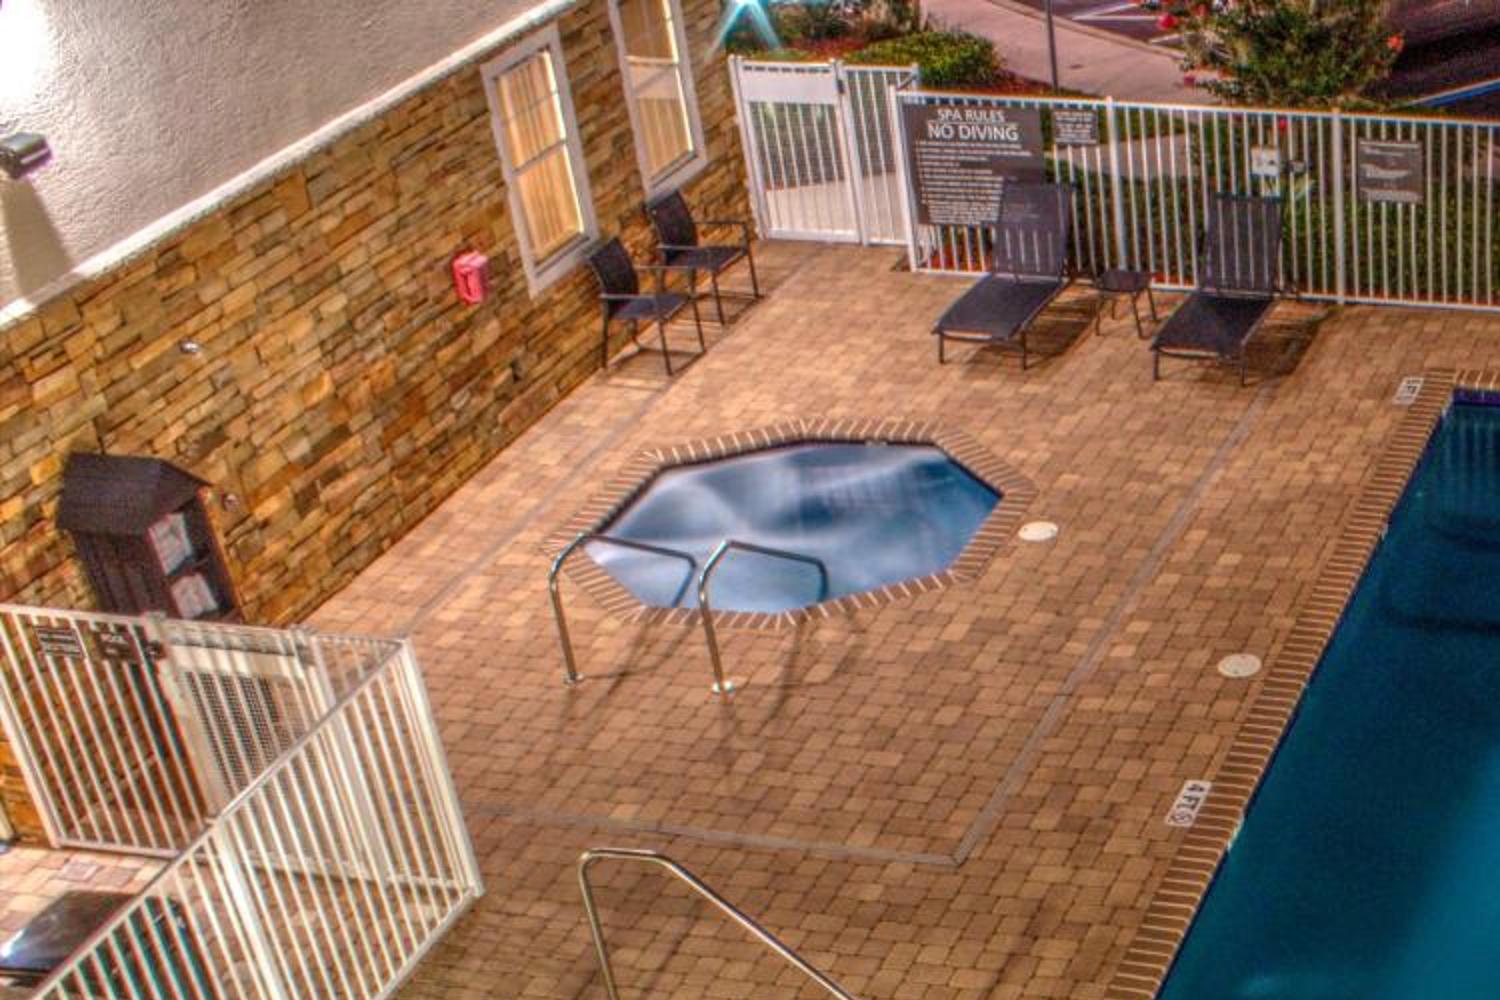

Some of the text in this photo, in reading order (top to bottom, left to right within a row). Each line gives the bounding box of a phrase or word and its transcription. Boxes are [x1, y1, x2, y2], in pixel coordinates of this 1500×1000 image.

[937, 107, 1005, 123] SPA RULES
[927, 122, 1019, 141] NO DIVING
